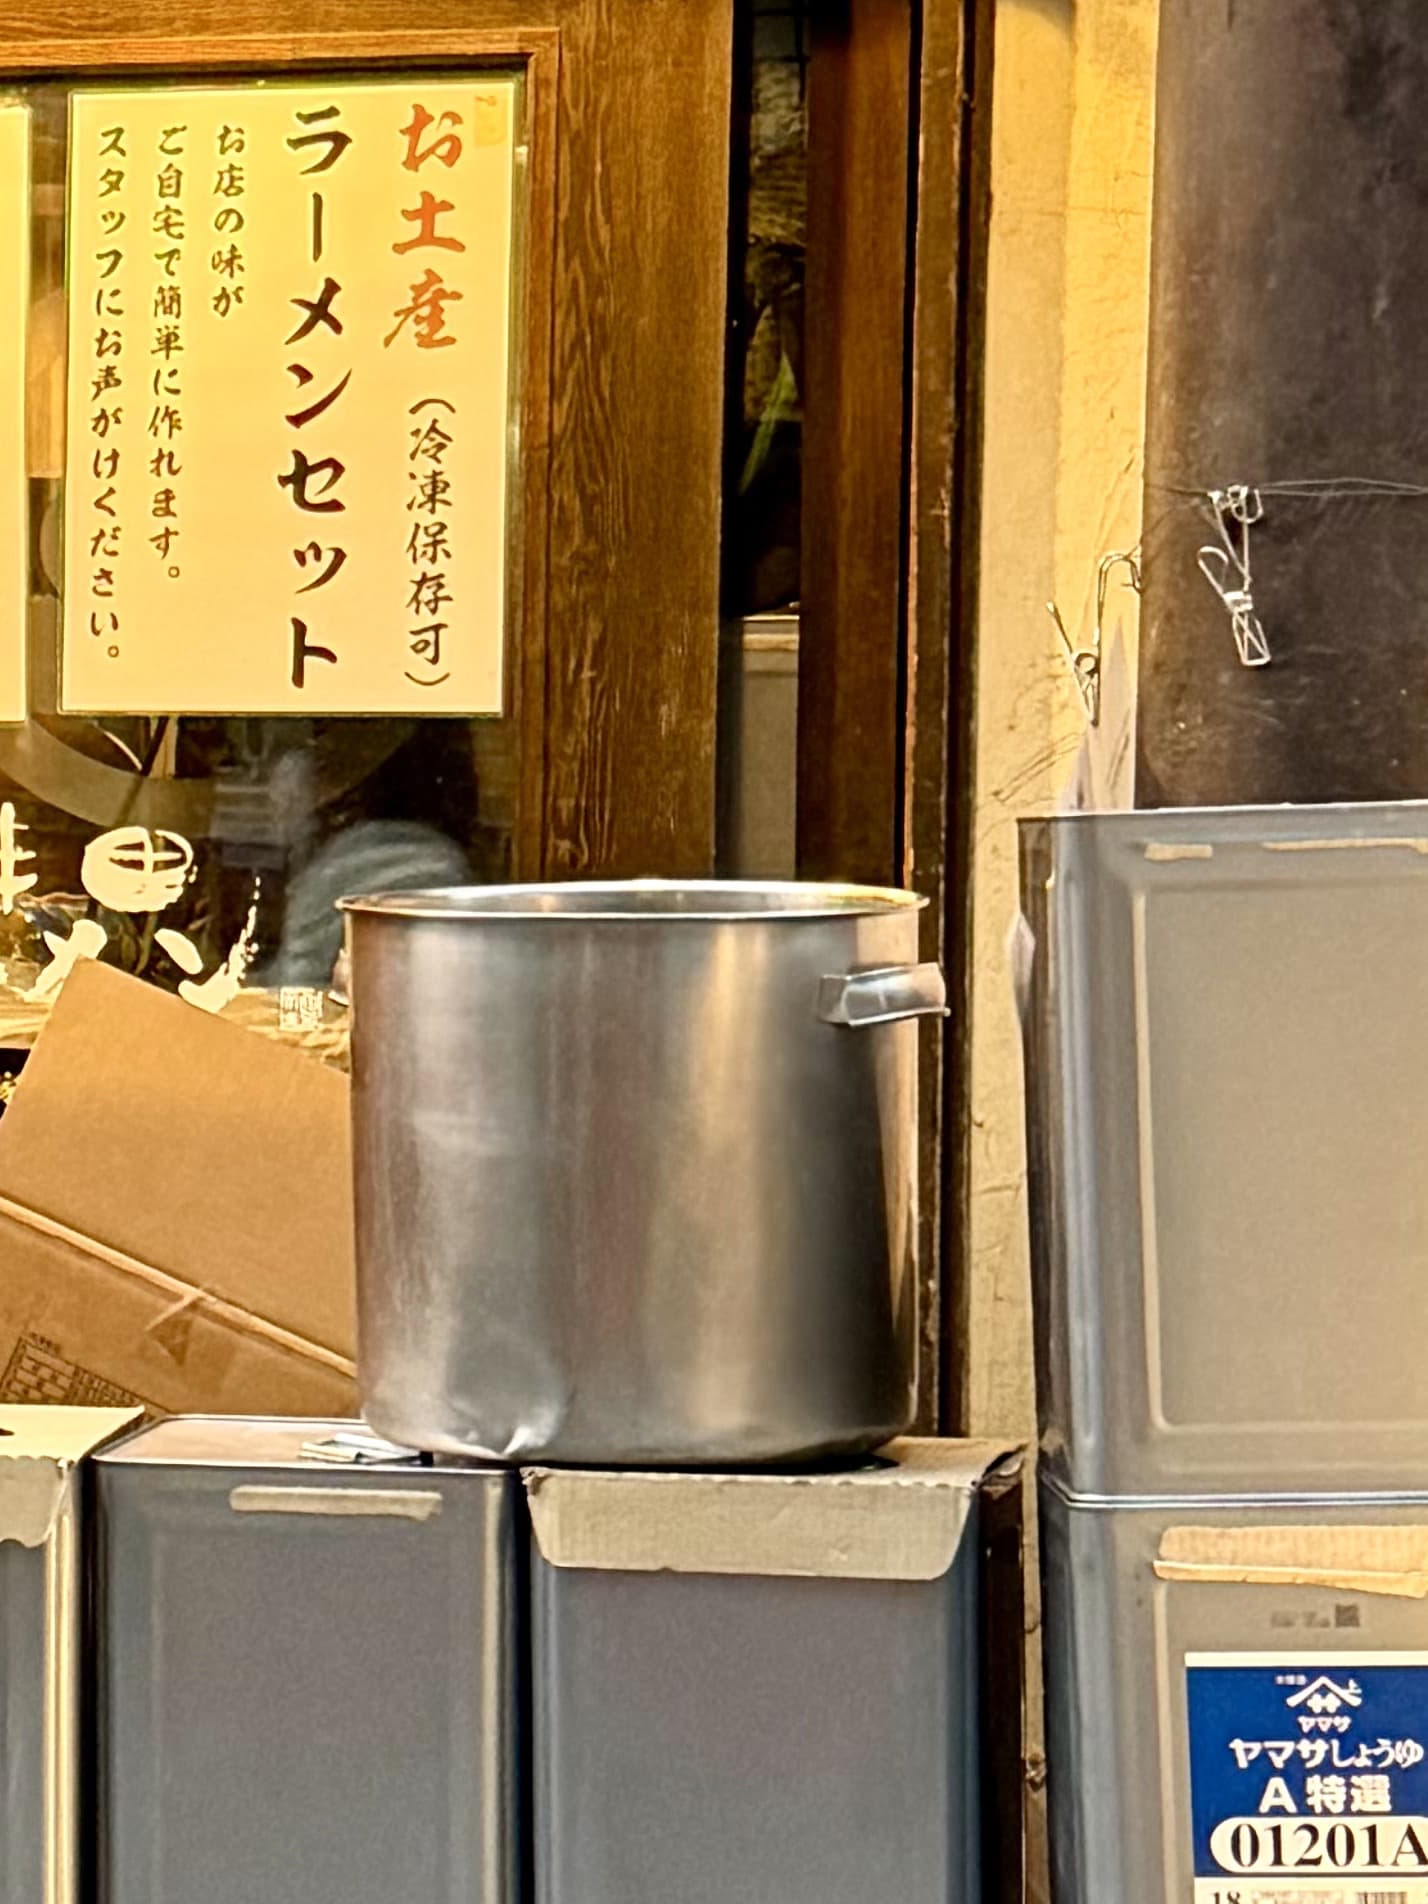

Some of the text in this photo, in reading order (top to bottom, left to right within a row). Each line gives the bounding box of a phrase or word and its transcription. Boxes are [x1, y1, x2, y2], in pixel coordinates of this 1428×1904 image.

[210, 123, 247, 318] お店の味が
[382, 101, 467, 351] お土産
[88, 125, 129, 661] スタッフにお声がけください。
[146, 123, 189, 582] ご自宅で簡単に作れます。
[276, 104, 354, 690] ラーメンセット
[1229, 1738, 1425, 1770] ヤマサしょうゆ
[1258, 1774, 1392, 1814] A 特選
[1297, 1715, 1352, 1733] ヤマサ
[1229, 1822, 1428, 1869] 01201A
